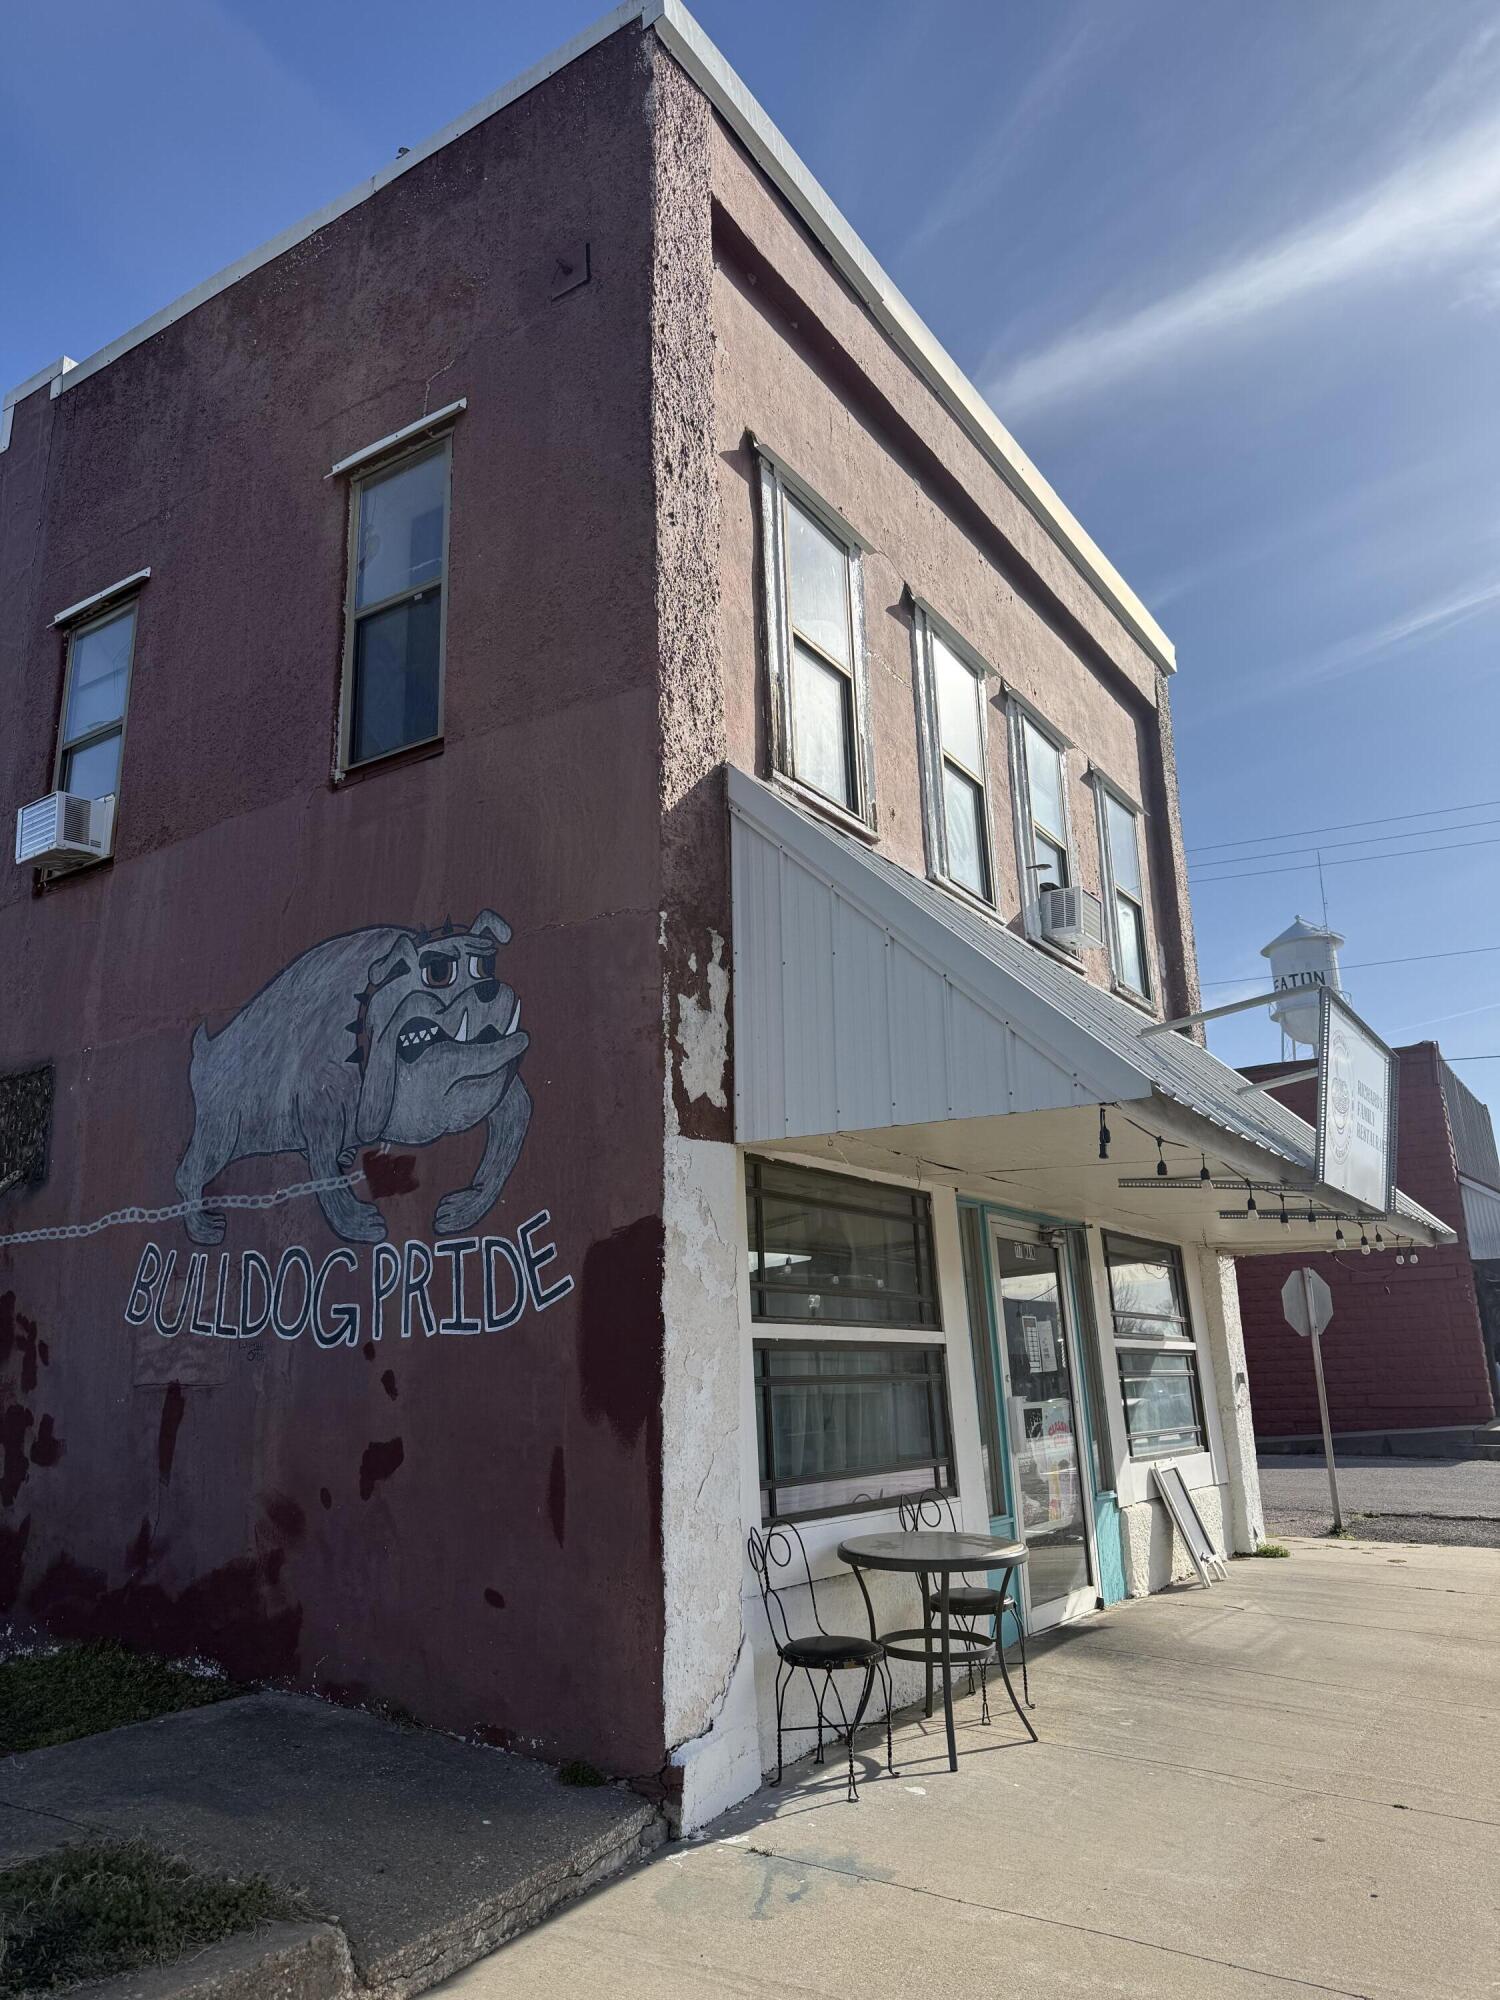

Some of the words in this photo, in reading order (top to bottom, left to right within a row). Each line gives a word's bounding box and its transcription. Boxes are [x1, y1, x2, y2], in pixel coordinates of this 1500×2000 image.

[1357, 1101, 1375, 1127] FAMILY
[1356, 1121, 1382, 1152] RESTAURA
[124, 1242, 360, 1348] BULLDOG
[372, 1209, 575, 1340] PRIDE
